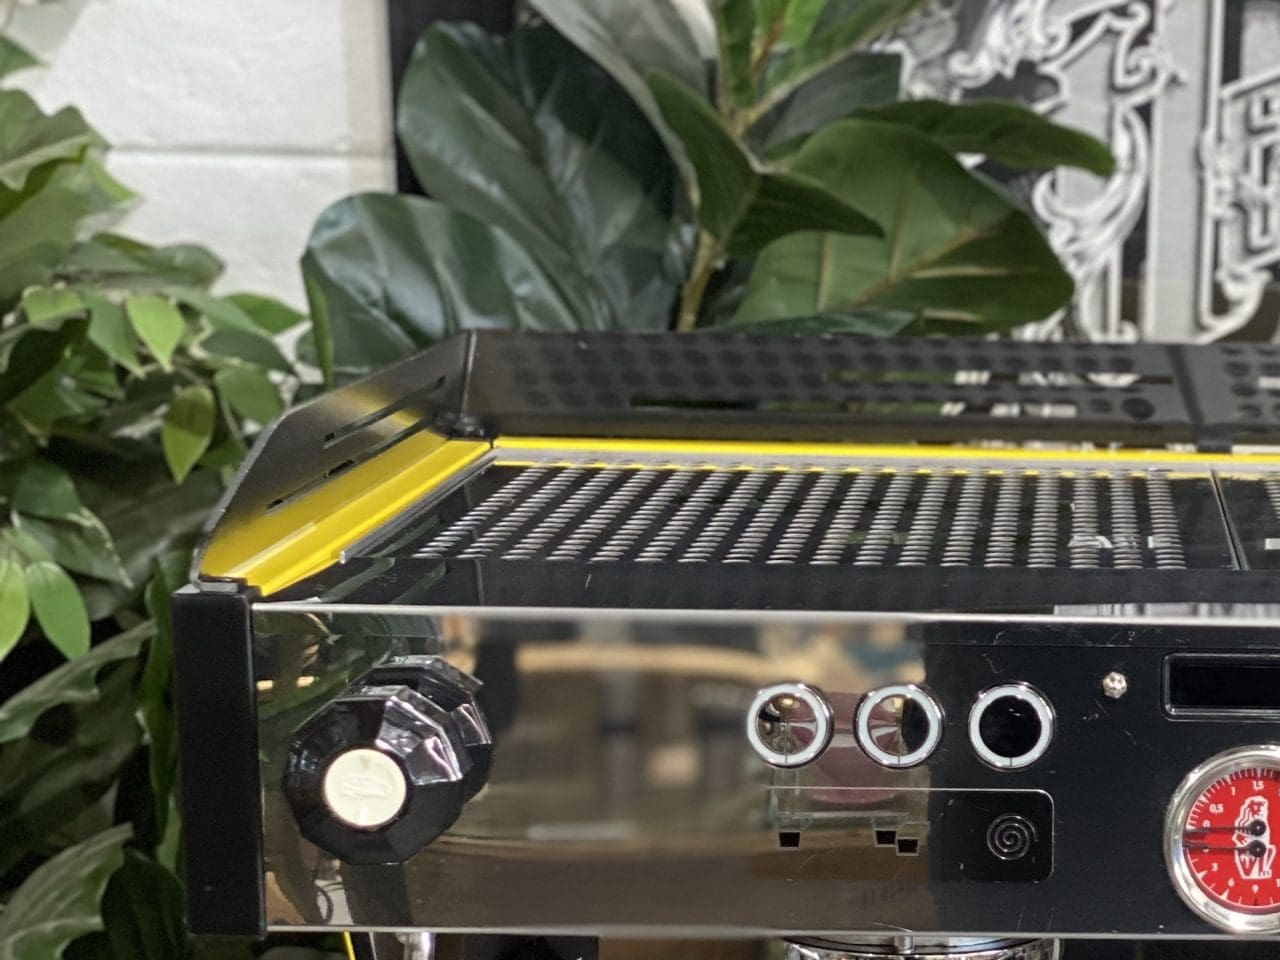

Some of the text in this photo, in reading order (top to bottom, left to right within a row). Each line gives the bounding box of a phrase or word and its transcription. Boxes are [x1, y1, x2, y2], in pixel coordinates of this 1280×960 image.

[1212, 862, 1219, 872] 3
[1228, 877, 1235, 887] 6
[1252, 884, 1259, 894] 9
